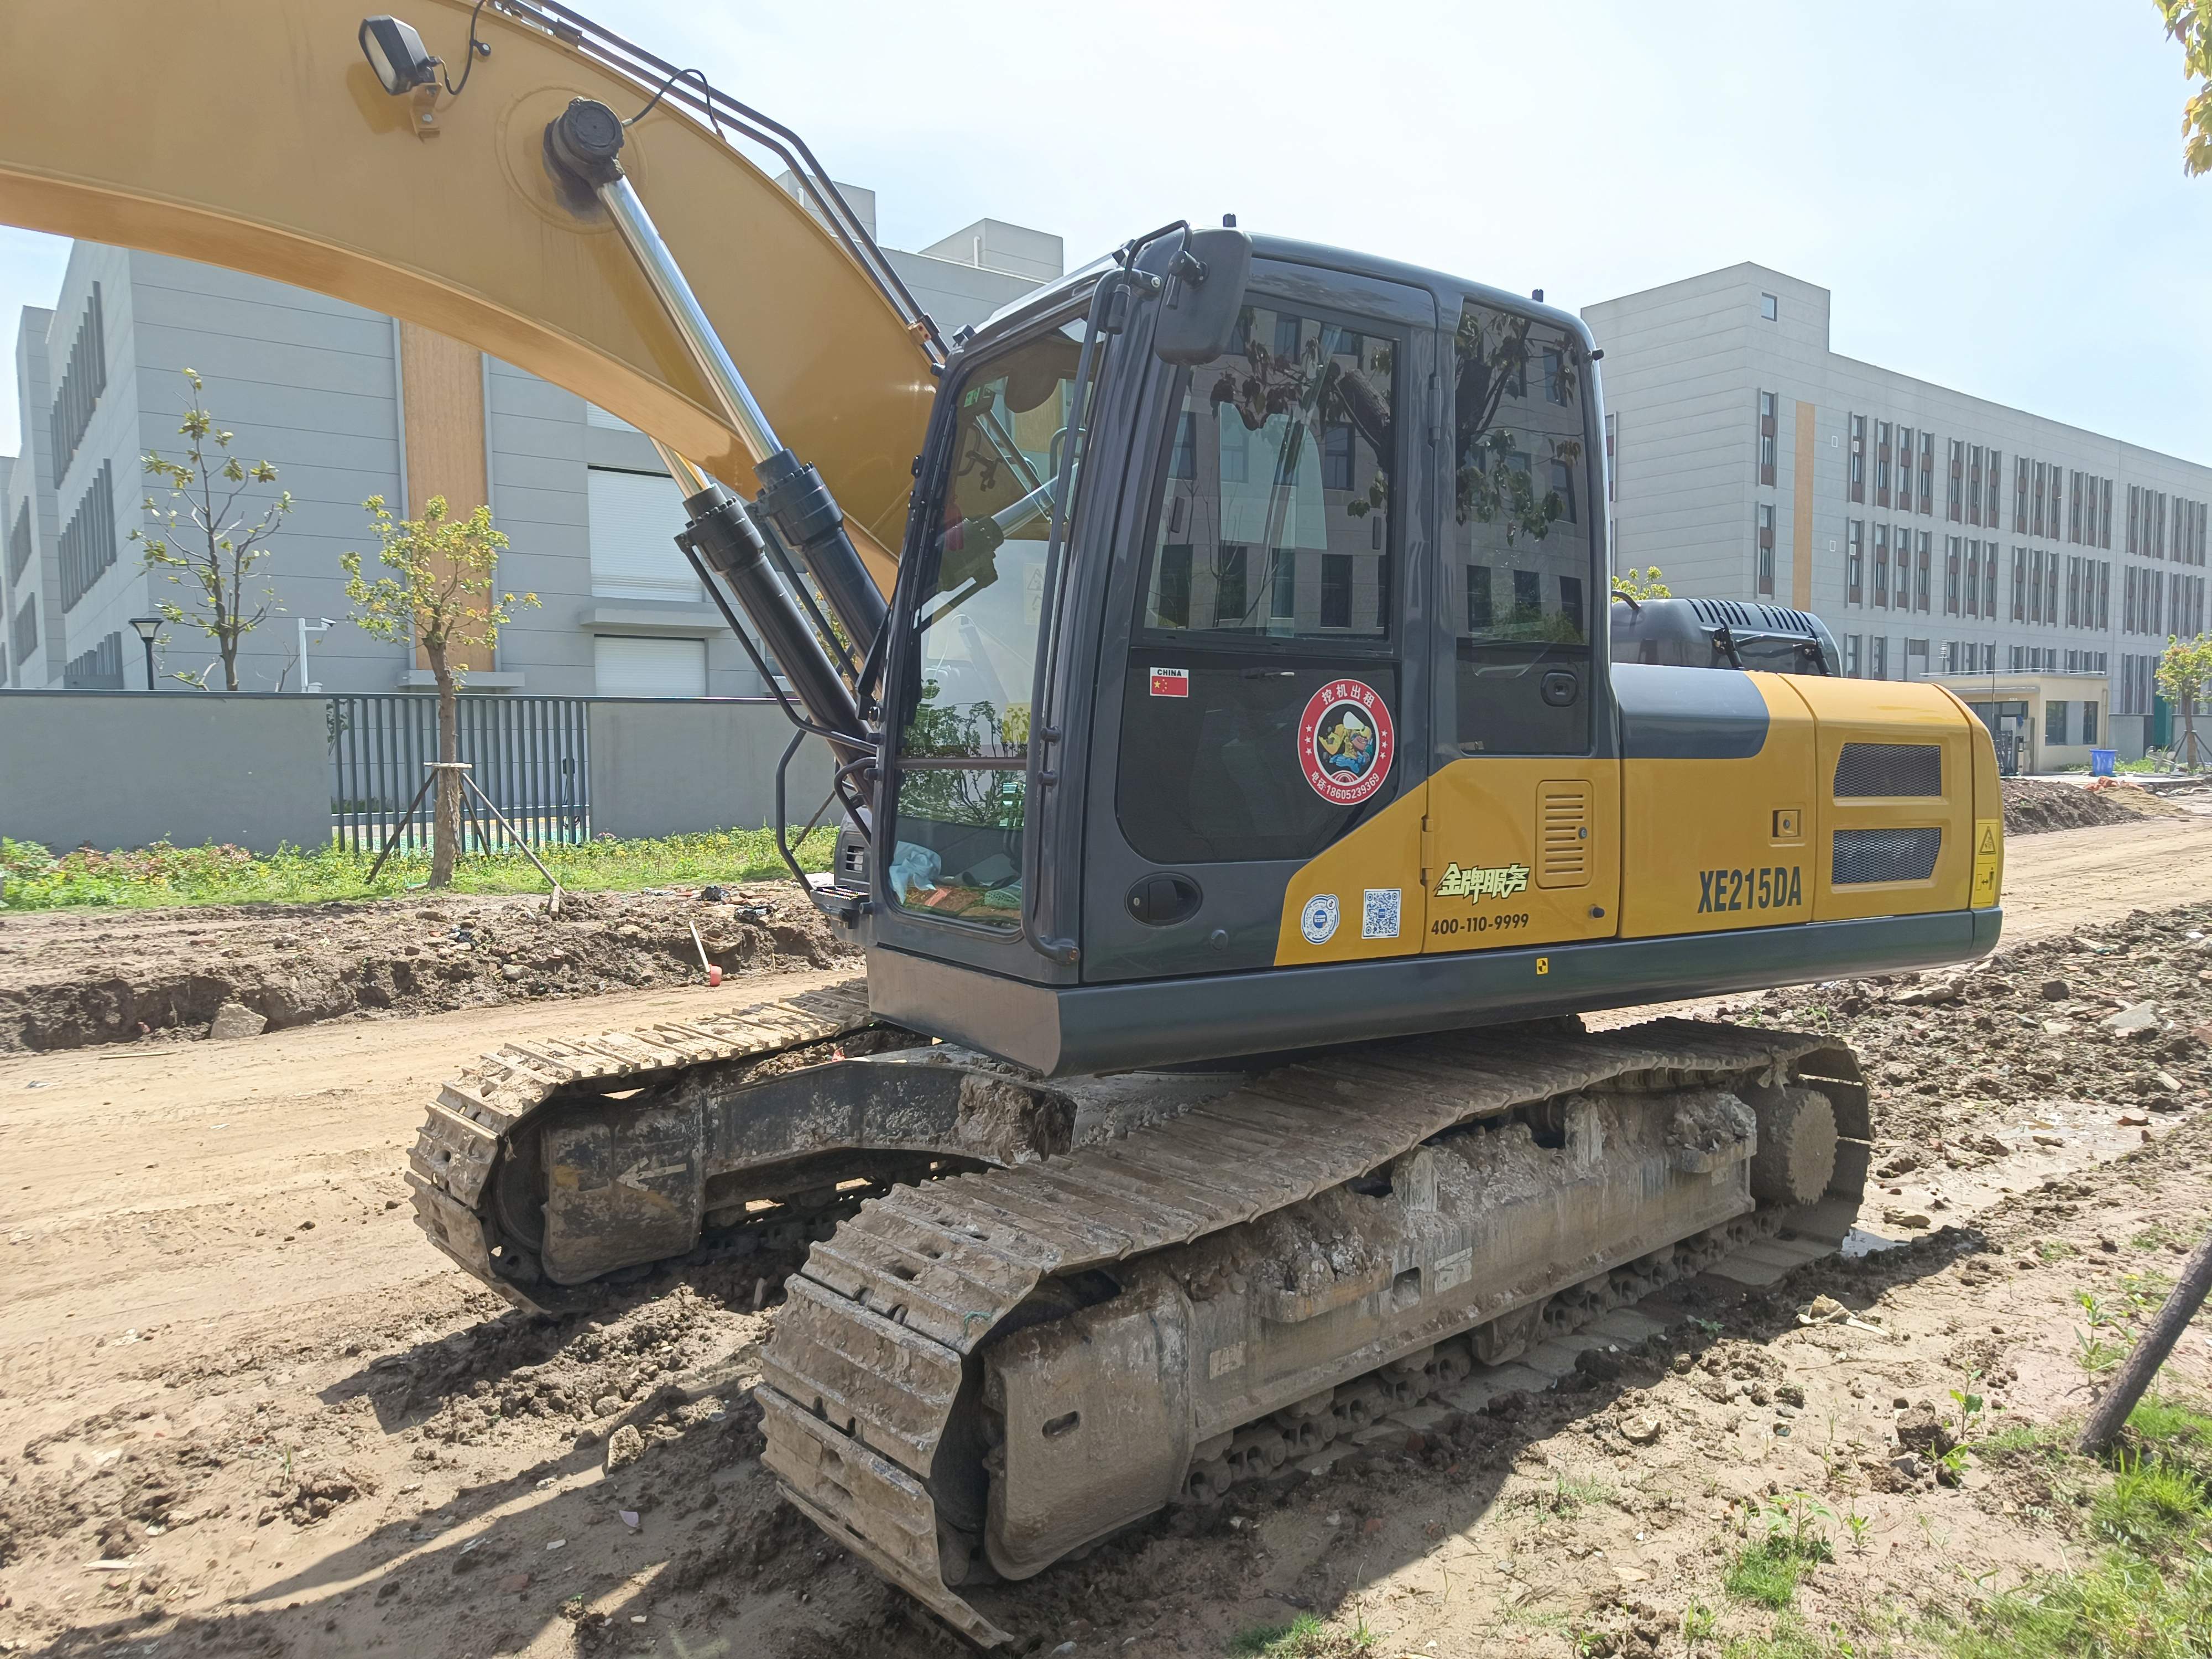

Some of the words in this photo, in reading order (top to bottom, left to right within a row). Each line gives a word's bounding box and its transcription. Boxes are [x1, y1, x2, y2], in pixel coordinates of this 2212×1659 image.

[1321, 684, 1375, 708] 挖机出租
[1434, 862, 1531, 905] 金牌服务
[1698, 866, 1802, 914] XE215DA
[1431, 913, 1530, 935] 400-110-9999
